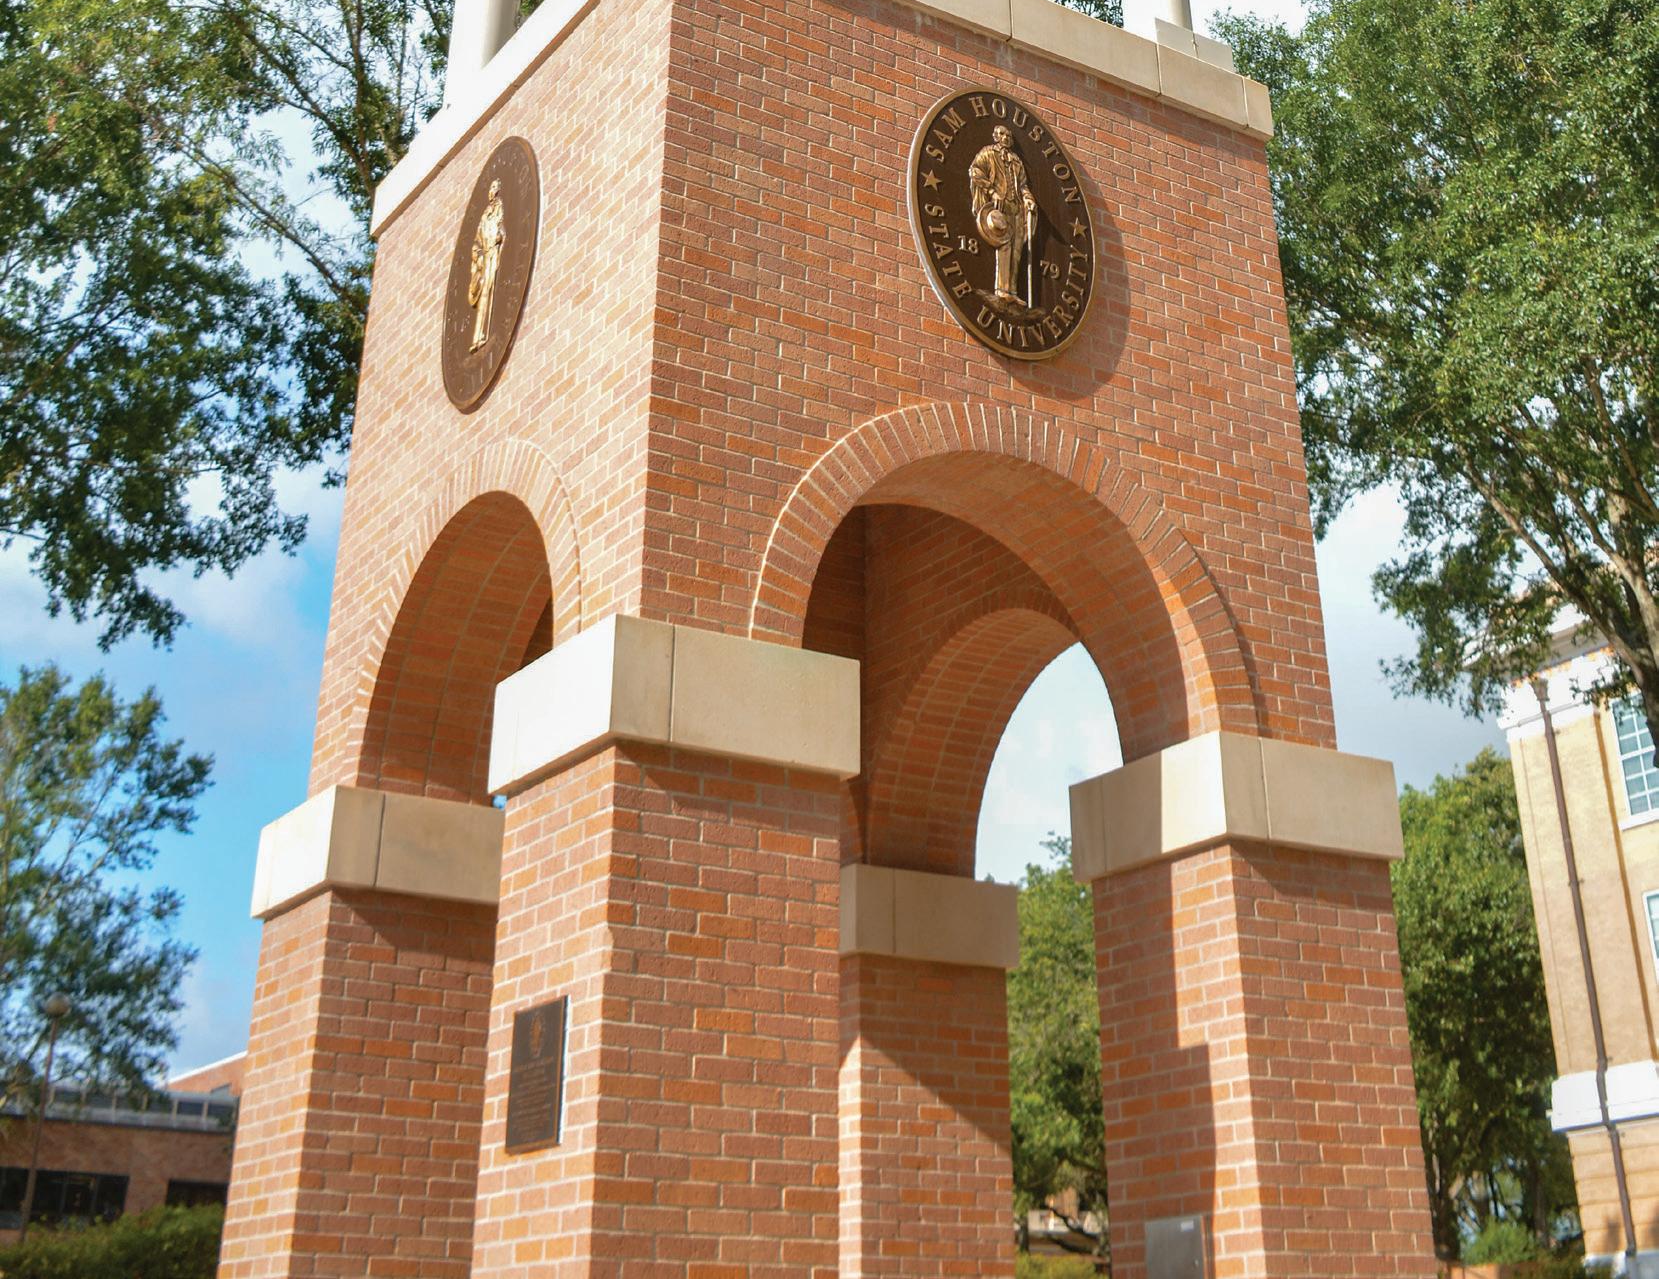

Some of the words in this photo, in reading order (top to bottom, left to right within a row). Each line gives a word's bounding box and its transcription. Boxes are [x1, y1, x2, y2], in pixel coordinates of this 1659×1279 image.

[925, 107, 967, 164] SAM
[968, 96, 1082, 205] HOUSTON
[925, 203, 973, 299] STATE
[976, 244, 1089, 348] UNIVERSITY
[957, 235, 980, 255] 18
[1039, 260, 1061, 280] 79
